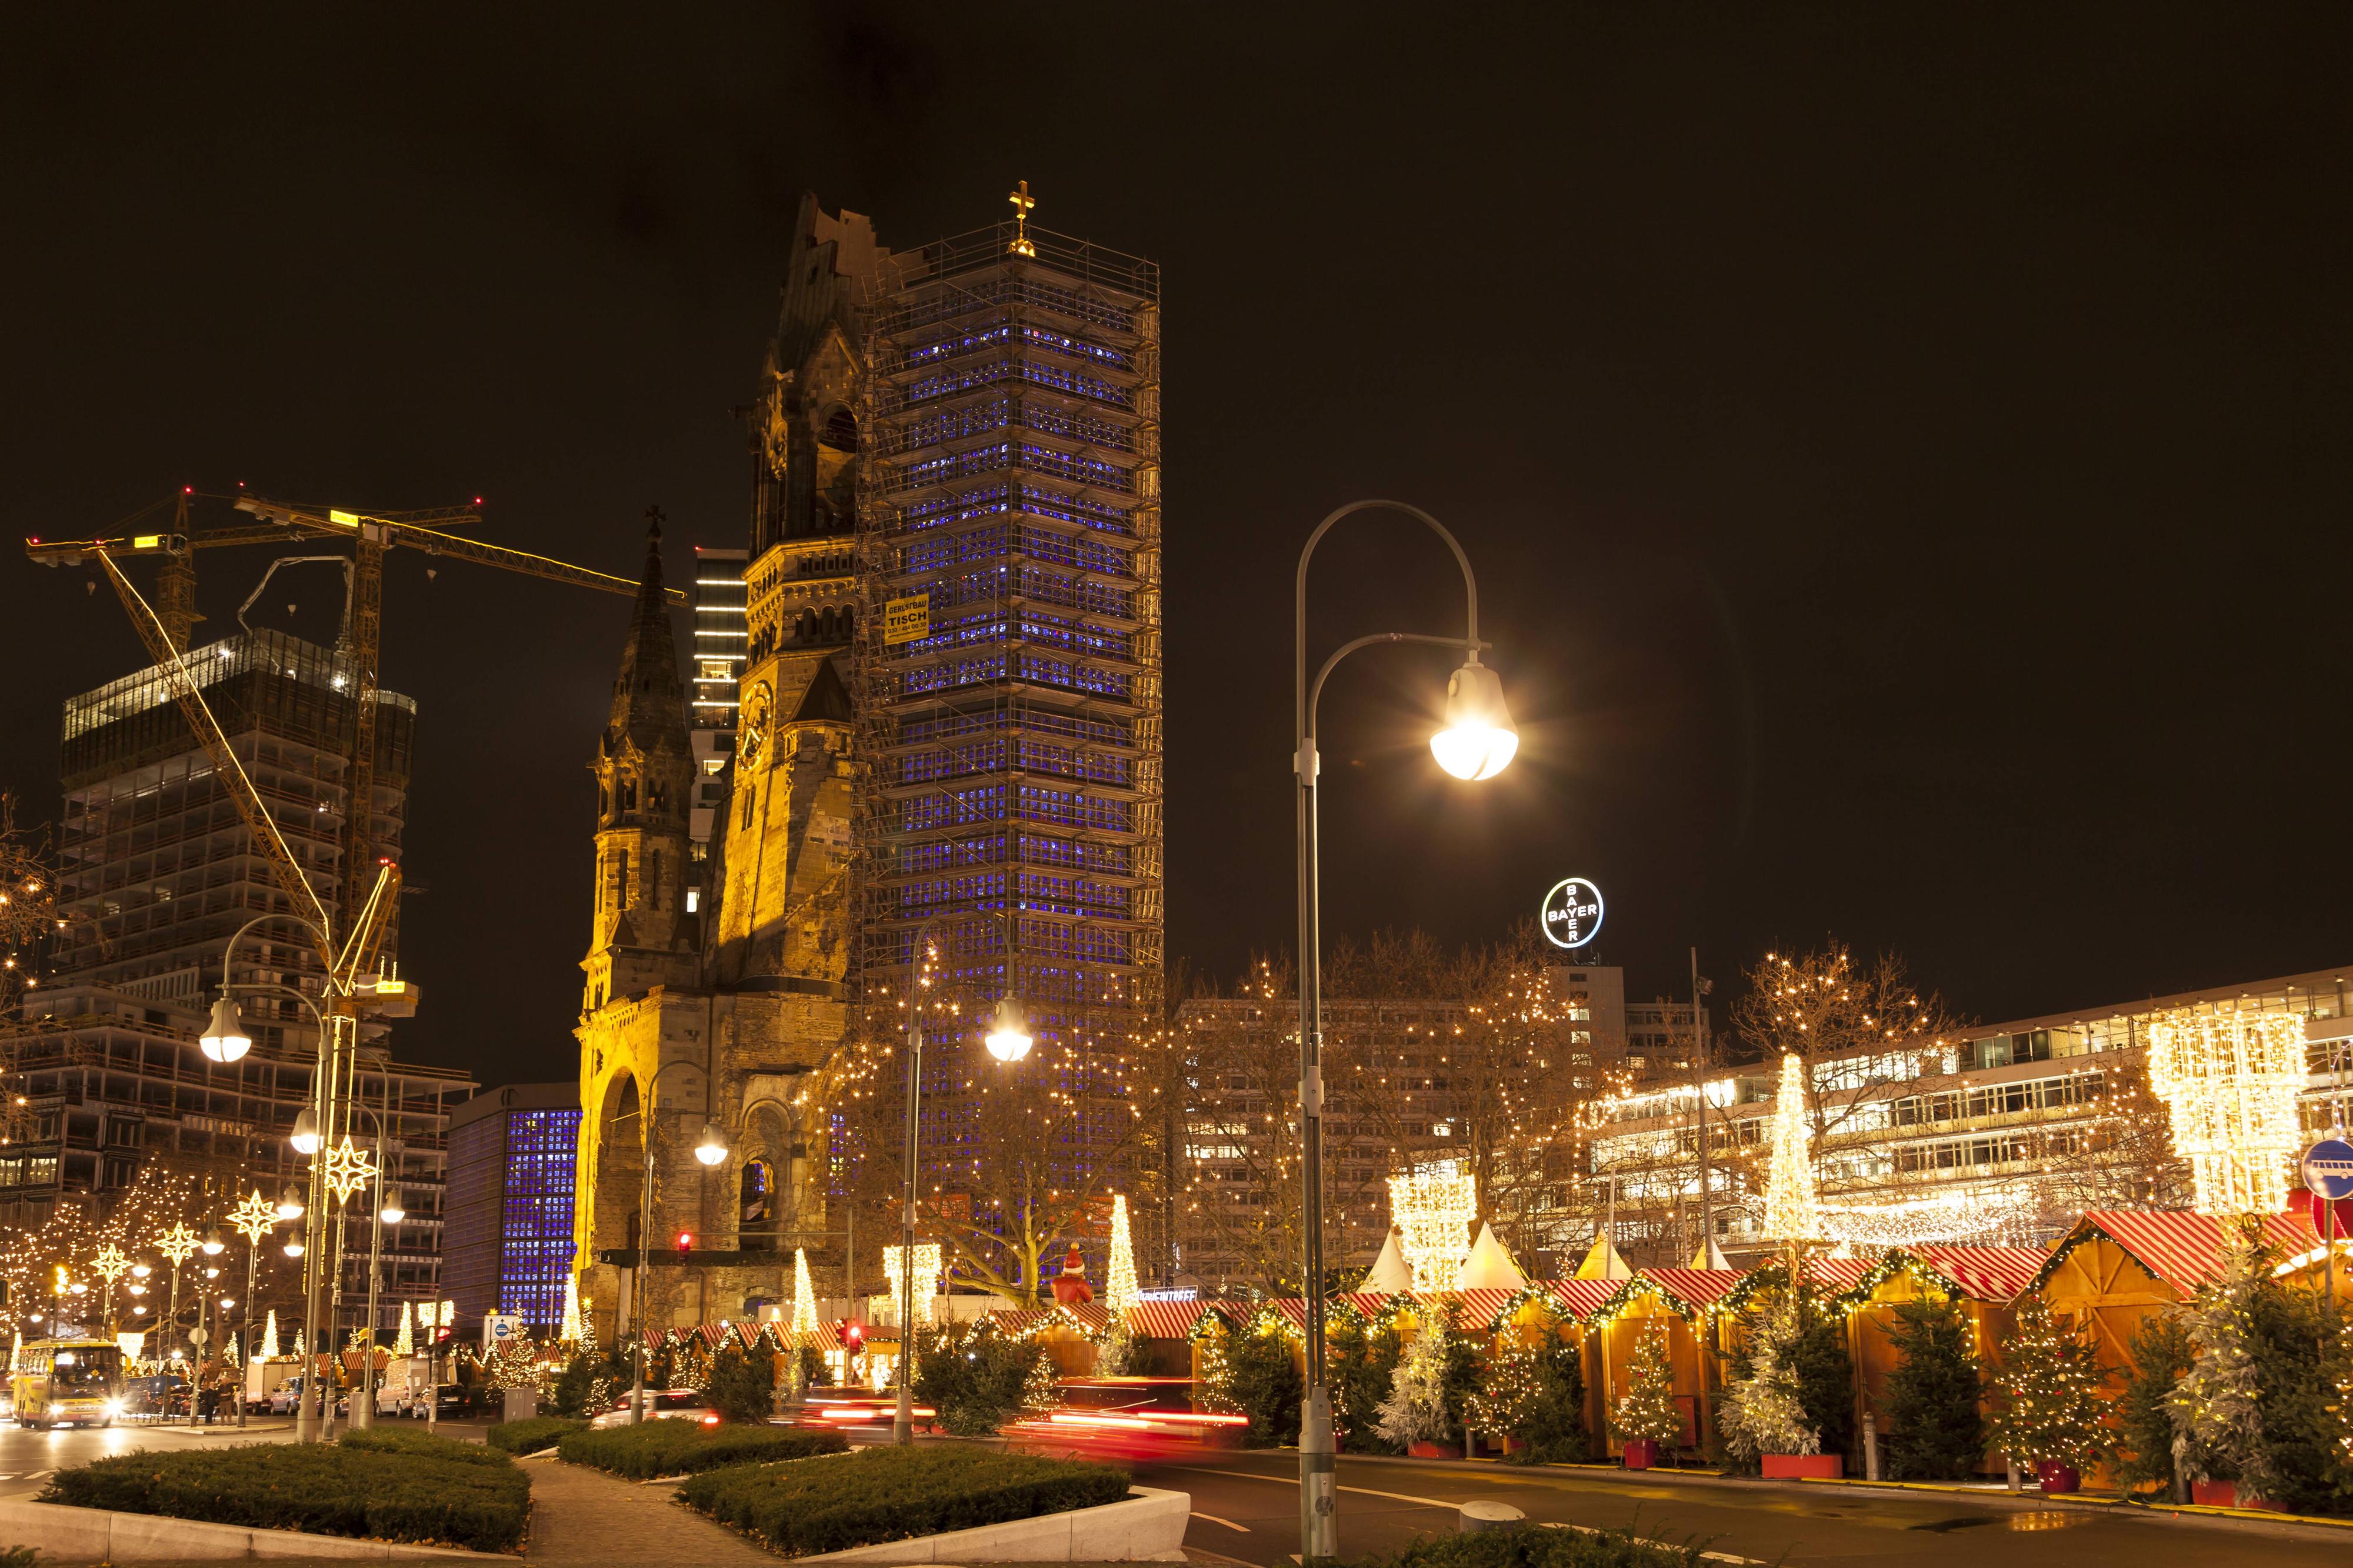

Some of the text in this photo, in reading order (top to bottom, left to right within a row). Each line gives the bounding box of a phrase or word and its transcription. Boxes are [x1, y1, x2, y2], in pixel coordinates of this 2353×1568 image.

[888, 611, 926, 626] TISCH
[1548, 904, 1597, 922] BAYER
[1567, 885, 1578, 942] BAYER
[340, 1056, 348, 1072] 3
